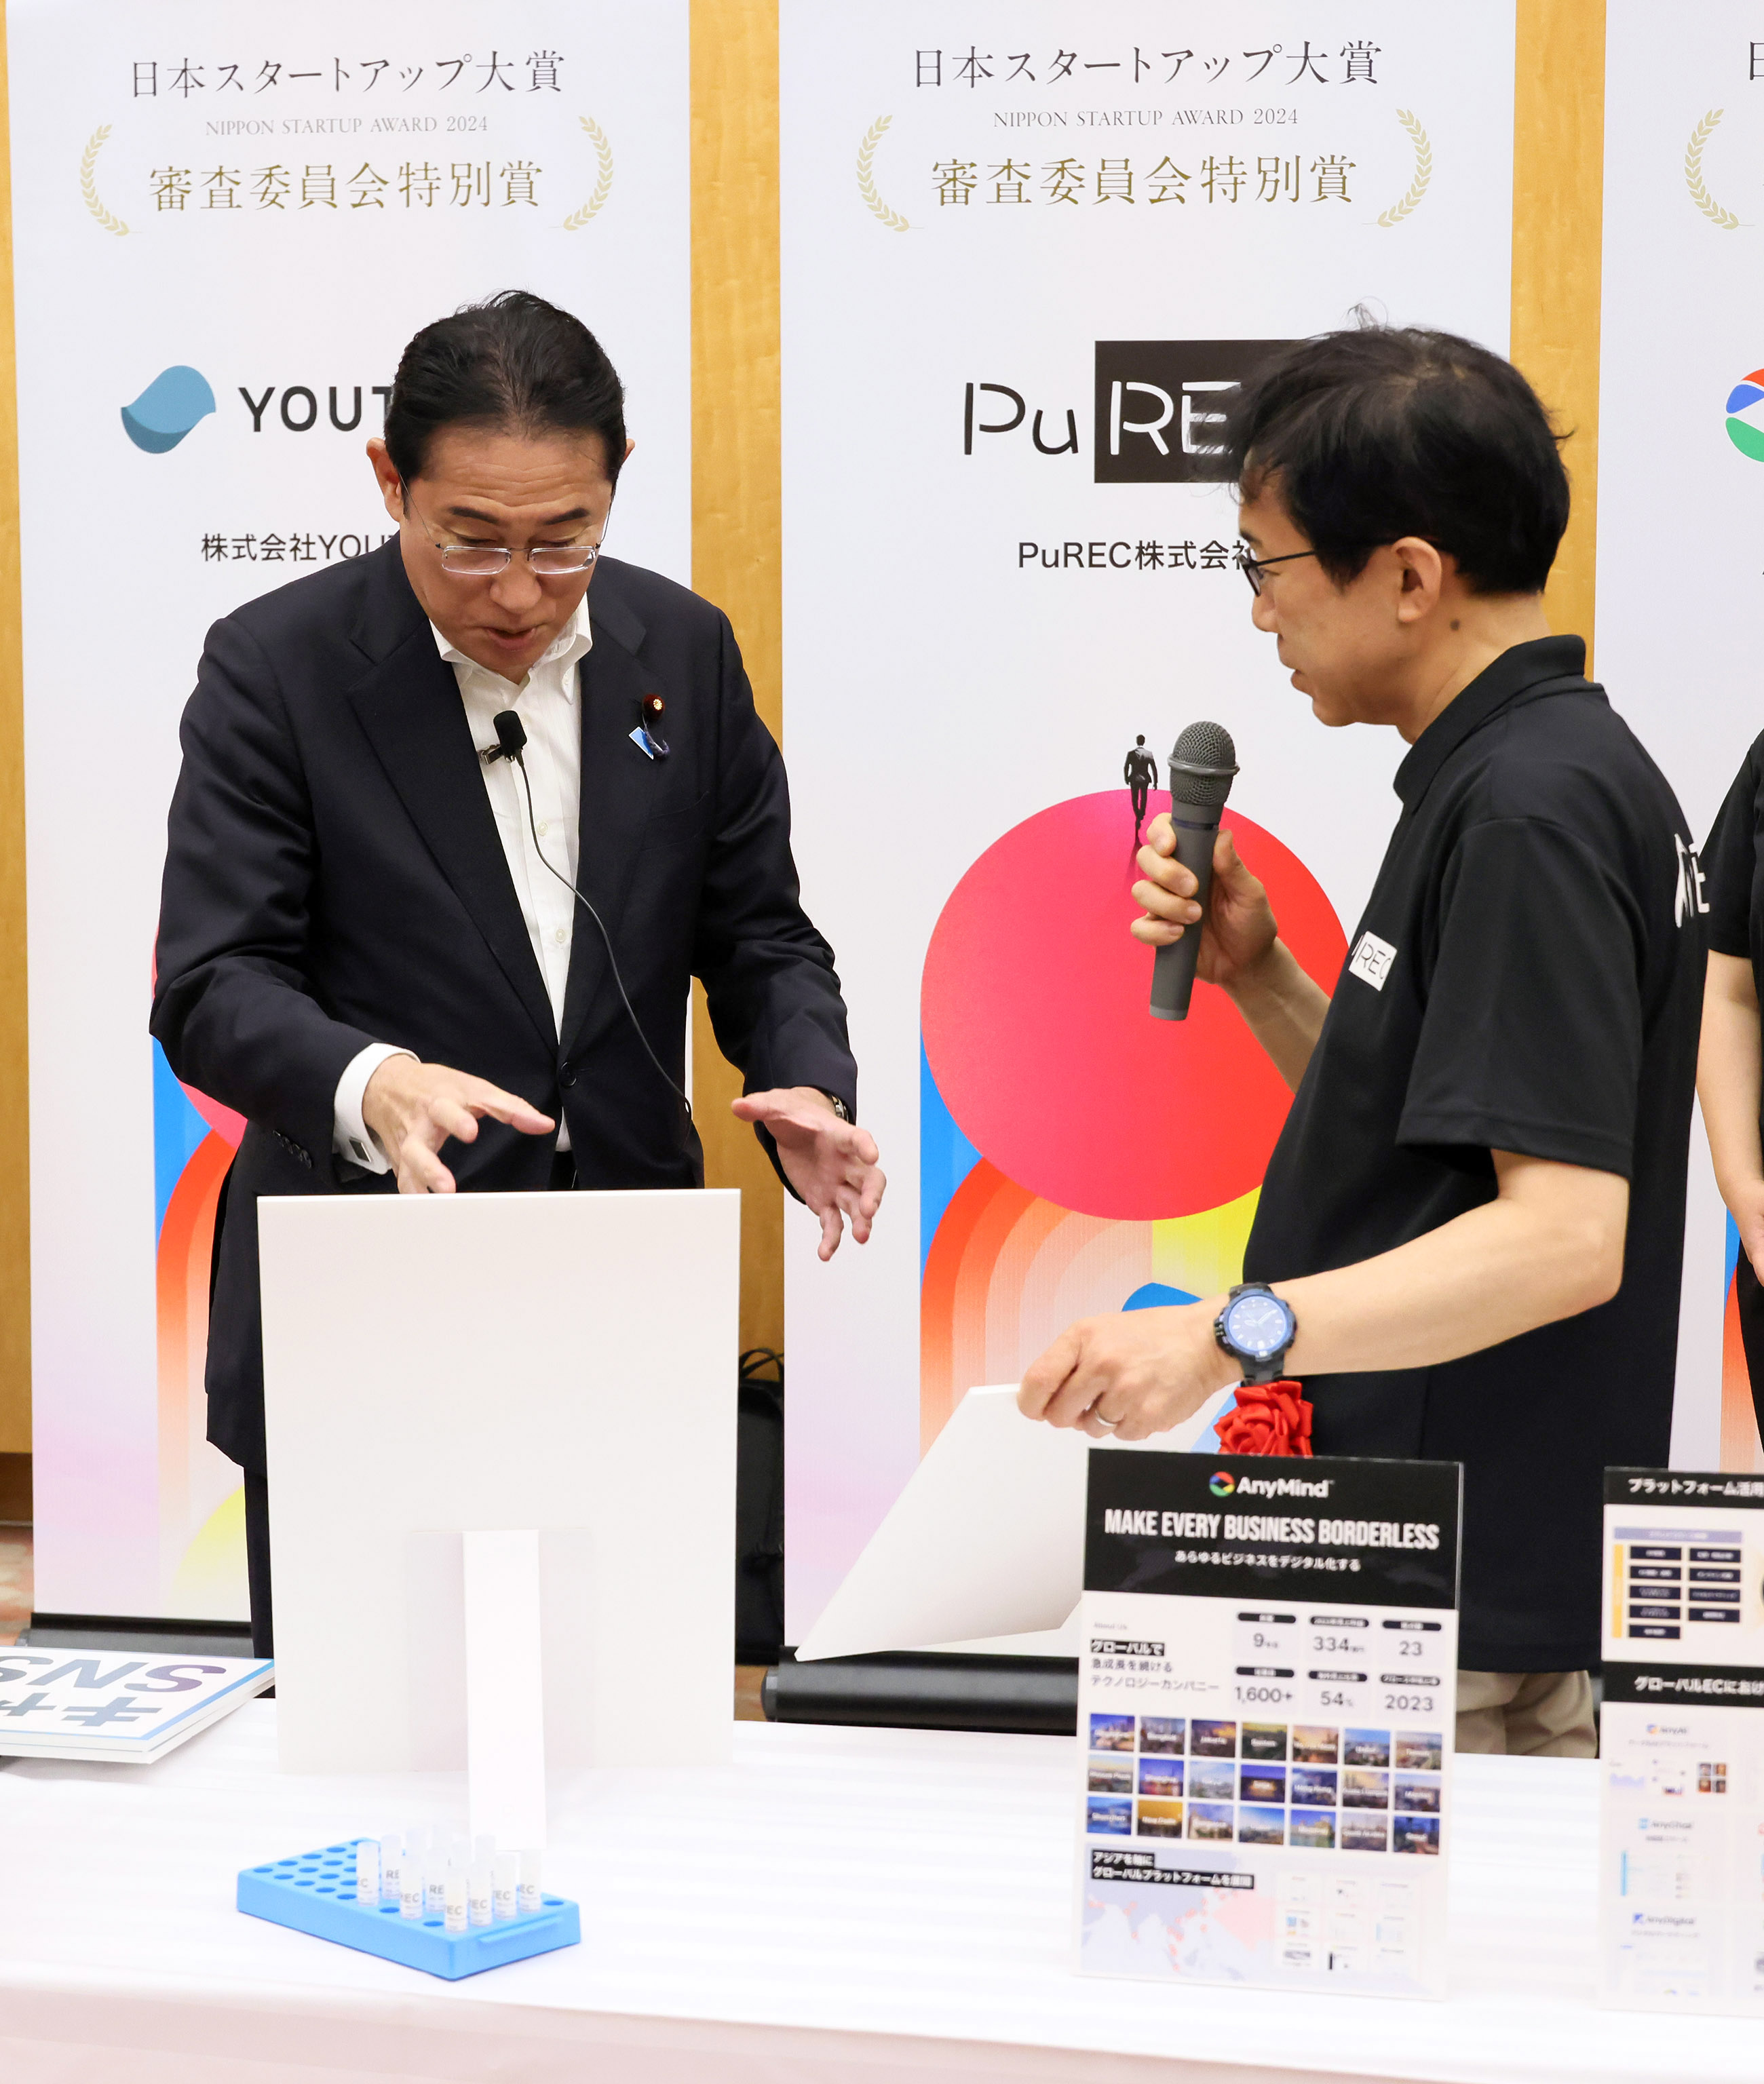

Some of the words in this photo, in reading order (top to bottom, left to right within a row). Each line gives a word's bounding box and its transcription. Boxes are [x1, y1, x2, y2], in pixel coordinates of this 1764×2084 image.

[132, 50, 564, 98] 日本スタートアップ大賞
[916, 41, 1382, 88] 日本スタートアップ大賞
[206, 119, 274, 136] NIPPON
[282, 118, 362, 134] STARTUP
[370, 117, 438, 132] AWARD
[446, 115, 488, 132] 2024
[994, 112, 1067, 128] NIPPON
[1077, 111, 1163, 126] STARTUP
[1172, 109, 1244, 126] AWARD
[1253, 109, 1298, 125] 2024
[150, 160, 543, 212] 審査委員会特別賞
[932, 155, 1357, 206] 審査委員会特別賞
[1105, 1509, 1159, 1536] MAKE
[1162, 1511, 1221, 1539] EVERY
[1224, 1514, 1316, 1544] BUSINESS
[1318, 1518, 1440, 1550] BORDERLESS
[1399, 1640, 1423, 1656] 23
[1385, 1695, 1434, 1711] 2023
